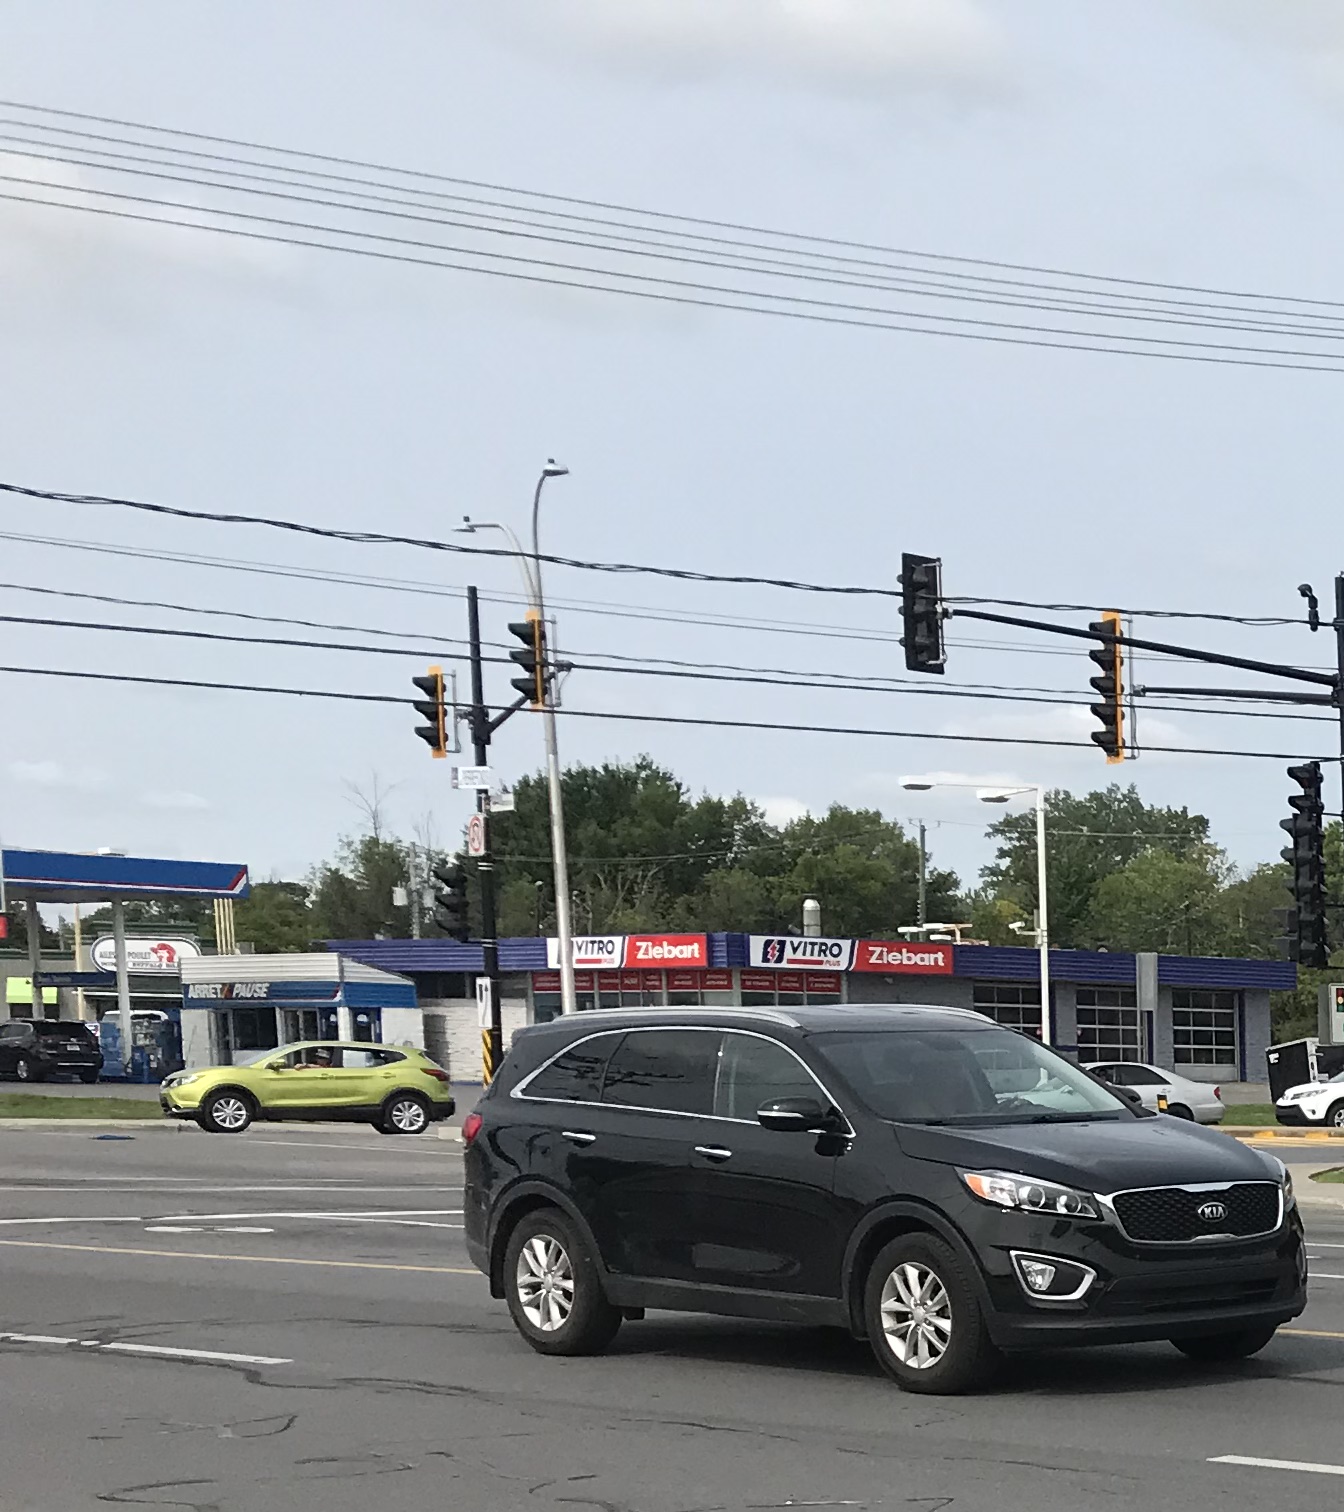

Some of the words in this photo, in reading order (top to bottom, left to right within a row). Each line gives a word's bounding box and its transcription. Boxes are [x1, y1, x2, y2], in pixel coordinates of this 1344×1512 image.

[575, 939, 615, 956] VITRO
[635, 941, 700, 960] Ziebart
[789, 940, 843, 958] VITRO
[867, 946, 945, 967] Ziebart
[232, 982, 270, 999] PAUSE
[1203, 1206, 1225, 1219] KIA
